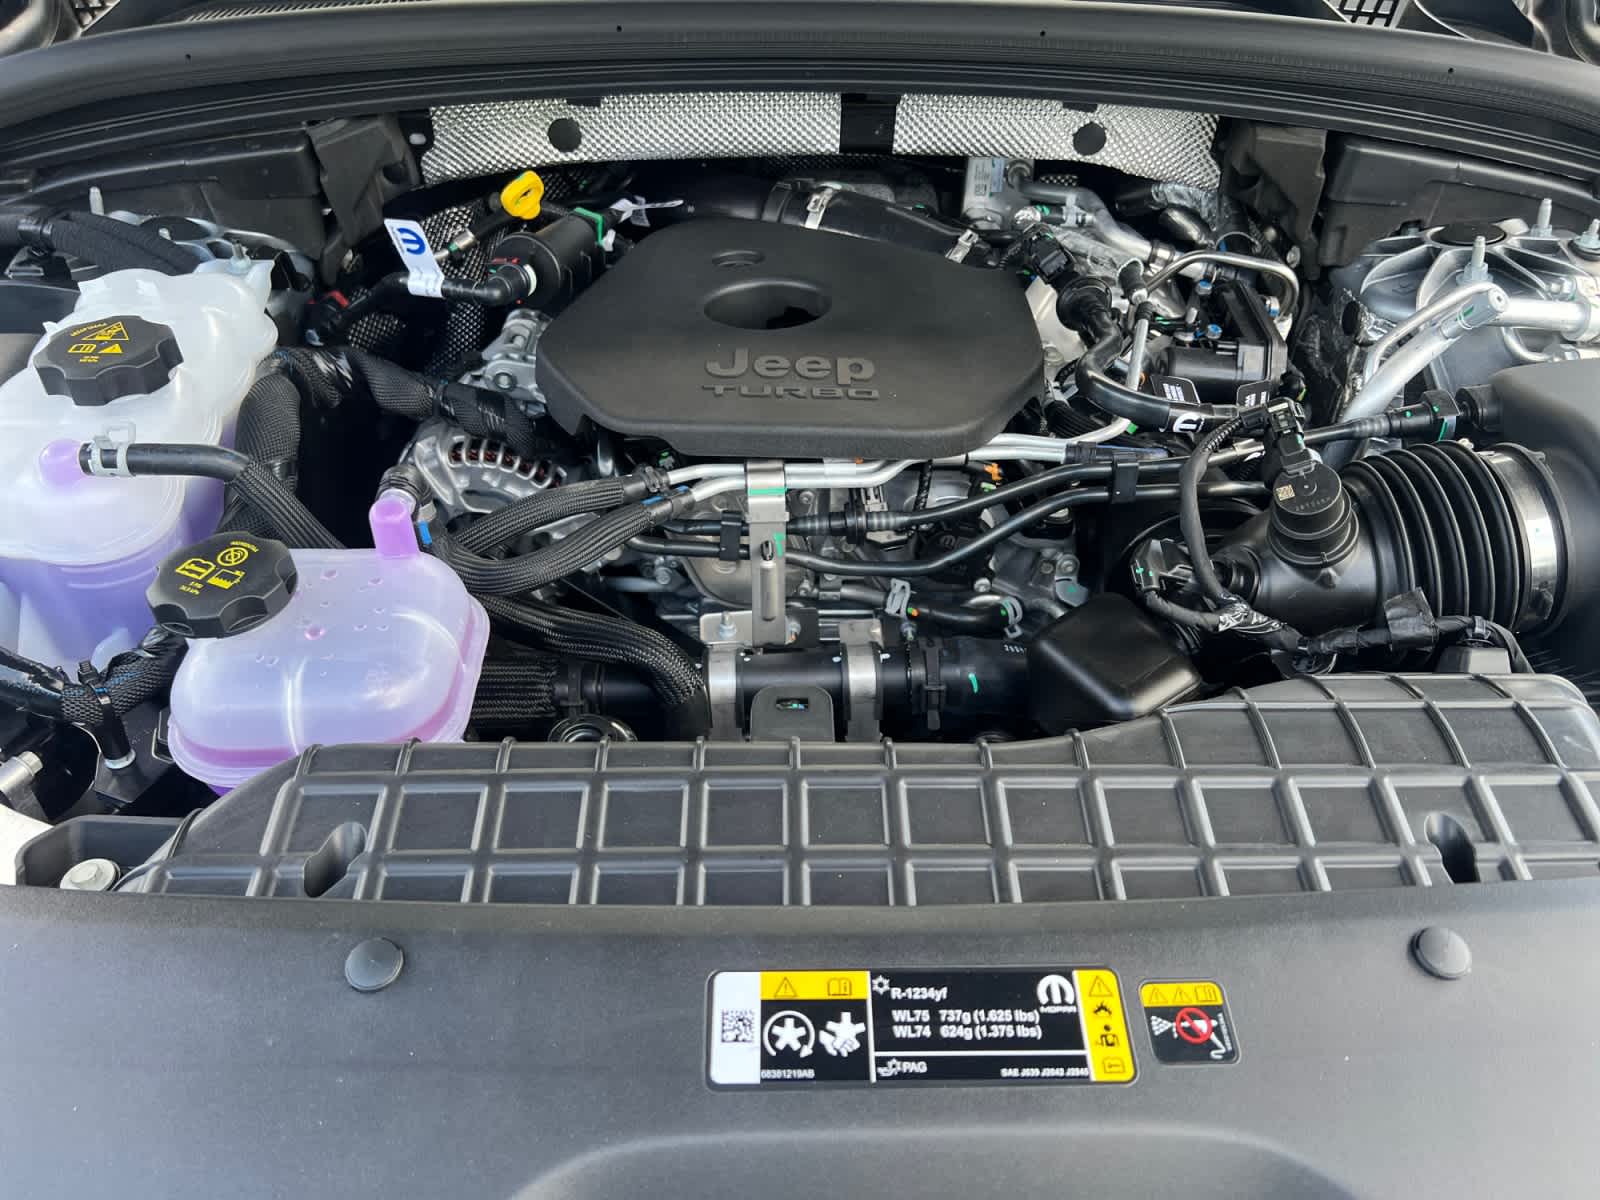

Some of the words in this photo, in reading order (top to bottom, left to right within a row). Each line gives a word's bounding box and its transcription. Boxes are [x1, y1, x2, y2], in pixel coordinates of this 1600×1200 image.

[705, 348, 875, 385] Jeep
[702, 385, 880, 400] TURBO
[890, 987, 948, 1002] R-1234yf
[891, 1009, 930, 1022] WL75
[939, 1009, 971, 1025] 737g
[973, 1009, 1013, 1024] (1.625
[1013, 1009, 1040, 1024] lbs)
[892, 1025, 931, 1038] WL74
[940, 1025, 973, 1040] 624g
[974, 1025, 1015, 1040] (1.375
[1015, 1024, 1043, 1040] lbs)
[903, 1061, 927, 1073] PAG
